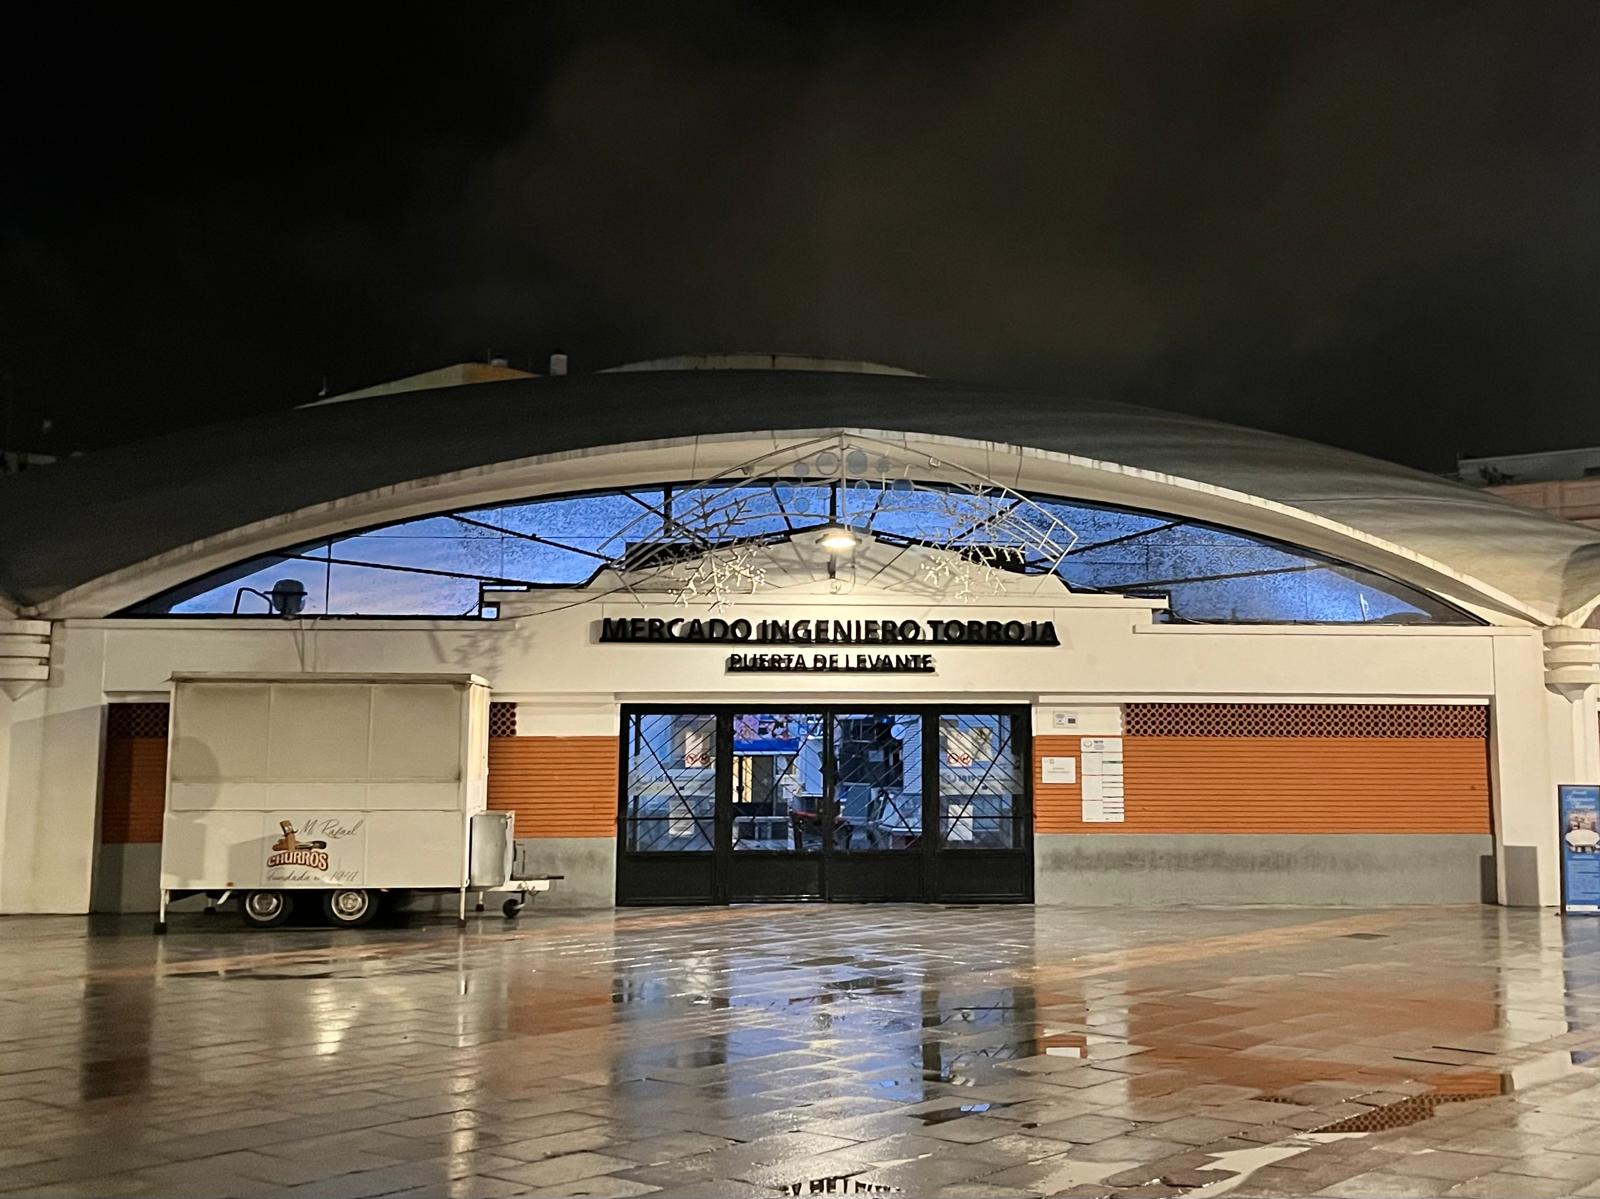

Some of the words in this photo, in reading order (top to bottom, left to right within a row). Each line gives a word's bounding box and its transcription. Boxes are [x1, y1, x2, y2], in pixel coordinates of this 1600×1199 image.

[601, 617, 753, 641] MERCADO
[761, 619, 921, 643] INGENIERO
[926, 619, 1060, 644] TORROJA
[729, 653, 807, 671] PUERTA
[813, 654, 839, 671] DE
[845, 654, 934, 671] LEVANTE
[320, 818, 364, 839] Rafael
[267, 850, 328, 871] CHURROS
